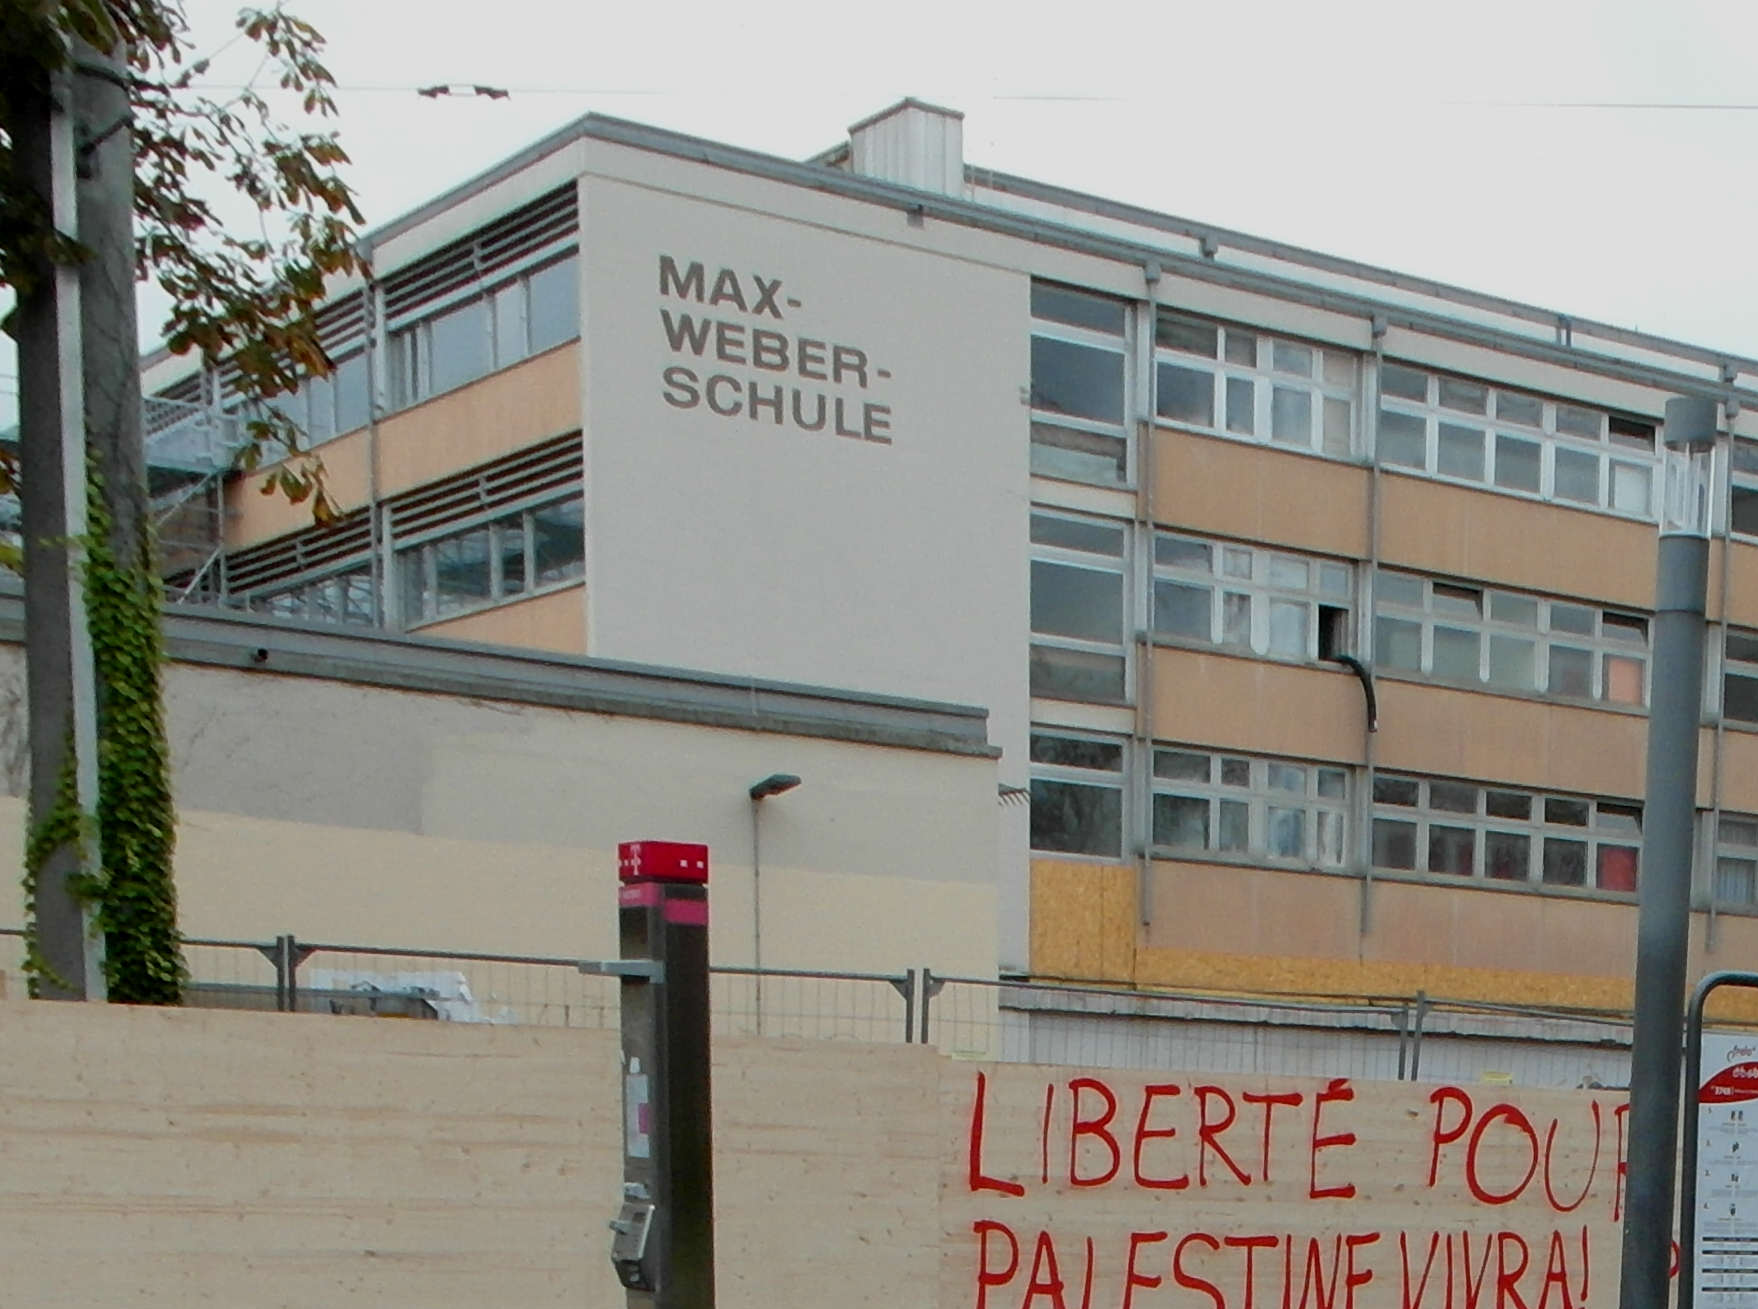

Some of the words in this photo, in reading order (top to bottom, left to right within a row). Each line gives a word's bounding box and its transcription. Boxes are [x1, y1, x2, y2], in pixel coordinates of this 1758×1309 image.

[659, 255, 802, 320] MAX-
[660, 308, 892, 389] WEBER-
[662, 366, 893, 446] SCHULE
[964, 1071, 1358, 1201] LIBERTÉ
